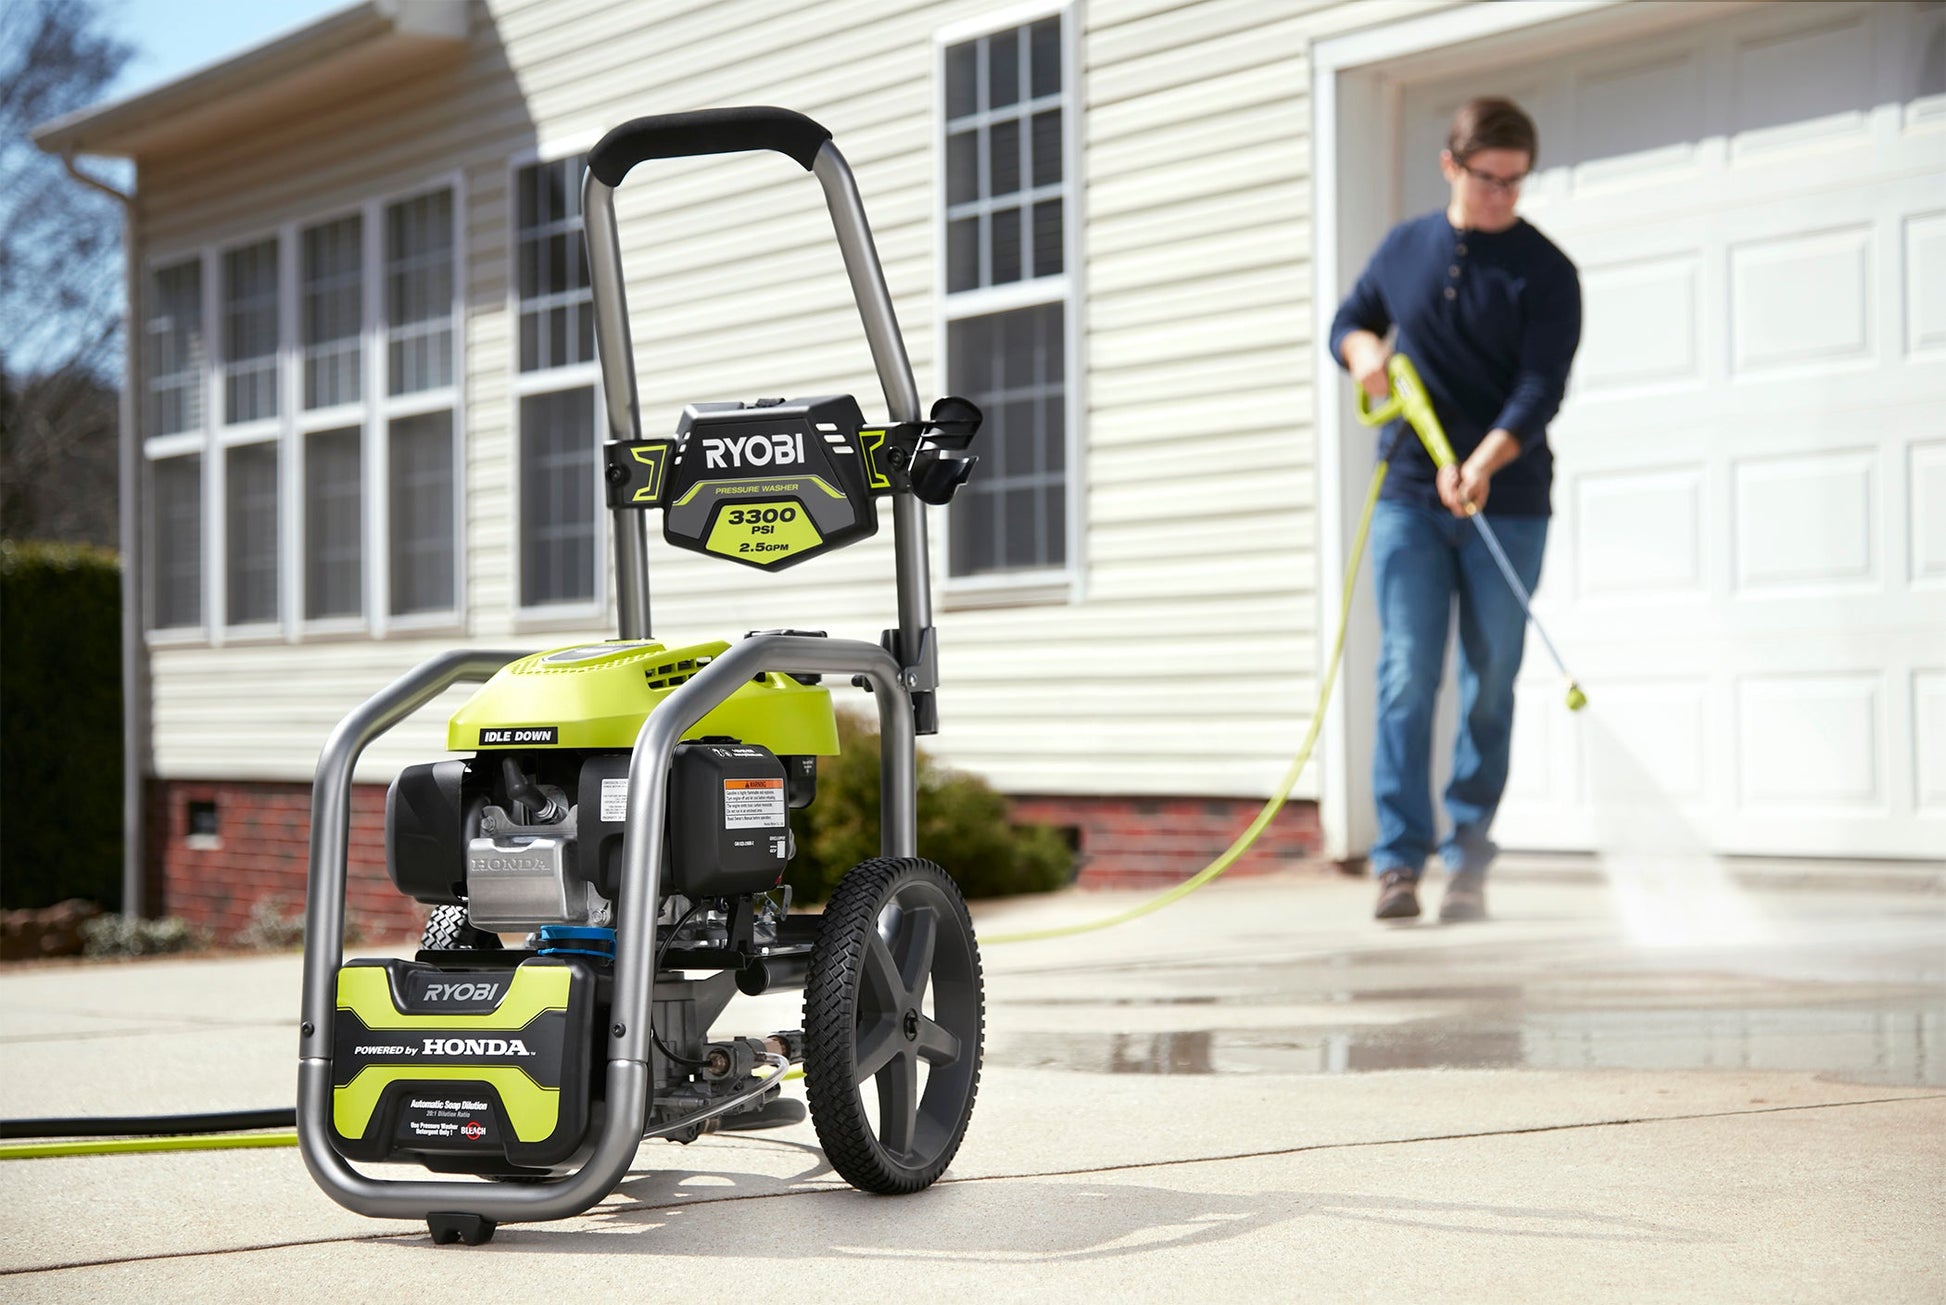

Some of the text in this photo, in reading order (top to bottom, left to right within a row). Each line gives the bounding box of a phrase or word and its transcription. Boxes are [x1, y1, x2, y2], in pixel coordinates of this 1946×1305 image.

[702, 433, 805, 469] RYOBI
[715, 483, 799, 495] PRESSURE WASHER
[728, 507, 796, 525] 3300
[751, 525, 774, 535] PSI
[484, 731, 551, 742] IDLE DOWN
[471, 859, 551, 872] HONDA
[423, 983, 499, 1001] RYOBI
[354, 1046, 404, 1056] POWERED
[404, 1046, 419, 1057] by
[421, 1038, 530, 1056] HONDA
[410, 1099, 488, 1111] Automatic Soap Dilution
[460, 1126, 487, 1136] BLEACH
